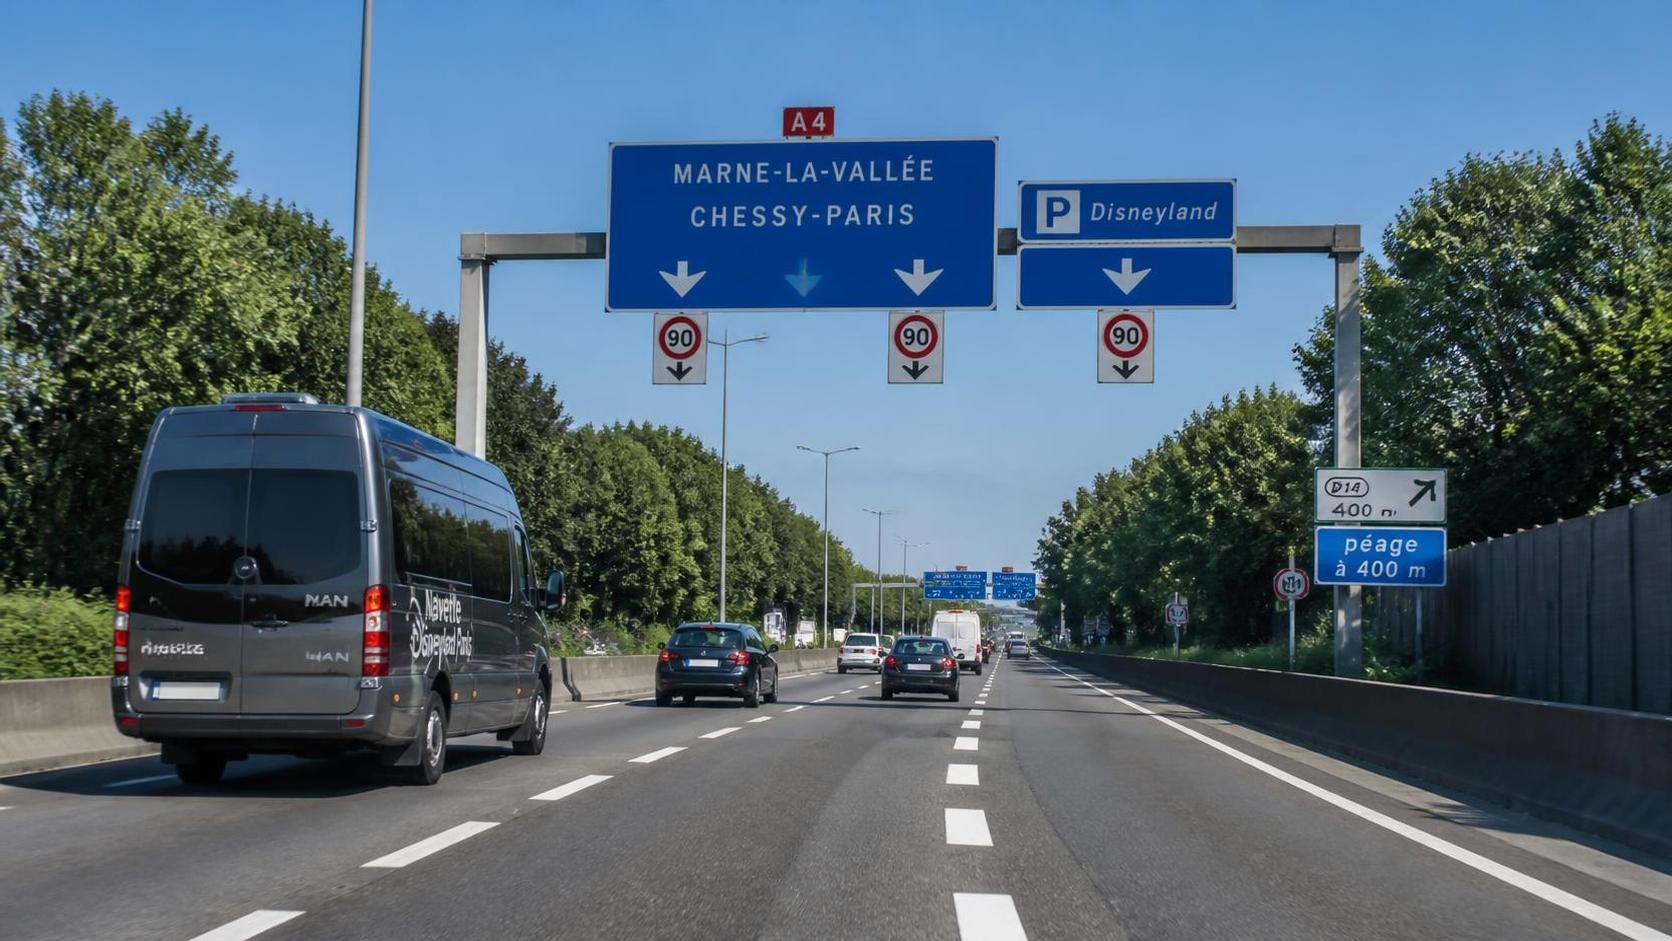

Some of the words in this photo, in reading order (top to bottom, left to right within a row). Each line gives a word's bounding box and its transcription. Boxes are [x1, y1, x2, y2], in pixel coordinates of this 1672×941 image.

[673, 155, 934, 184] MARNE-LA-VALLÉE
[690, 203, 914, 227] CHESSY-PARIS
[1046, 197, 1071, 228] P
[1090, 201, 1218, 226] Disneyland
[667, 329, 693, 347] 90
[903, 328, 929, 346] 90
[1112, 327, 1140, 345] 90
[1332, 502, 1372, 517] 400
[1344, 534, 1418, 557] péage
[1335, 560, 1346, 577] à
[1356, 560, 1398, 577] 400
[1408, 565, 1426, 578] m
